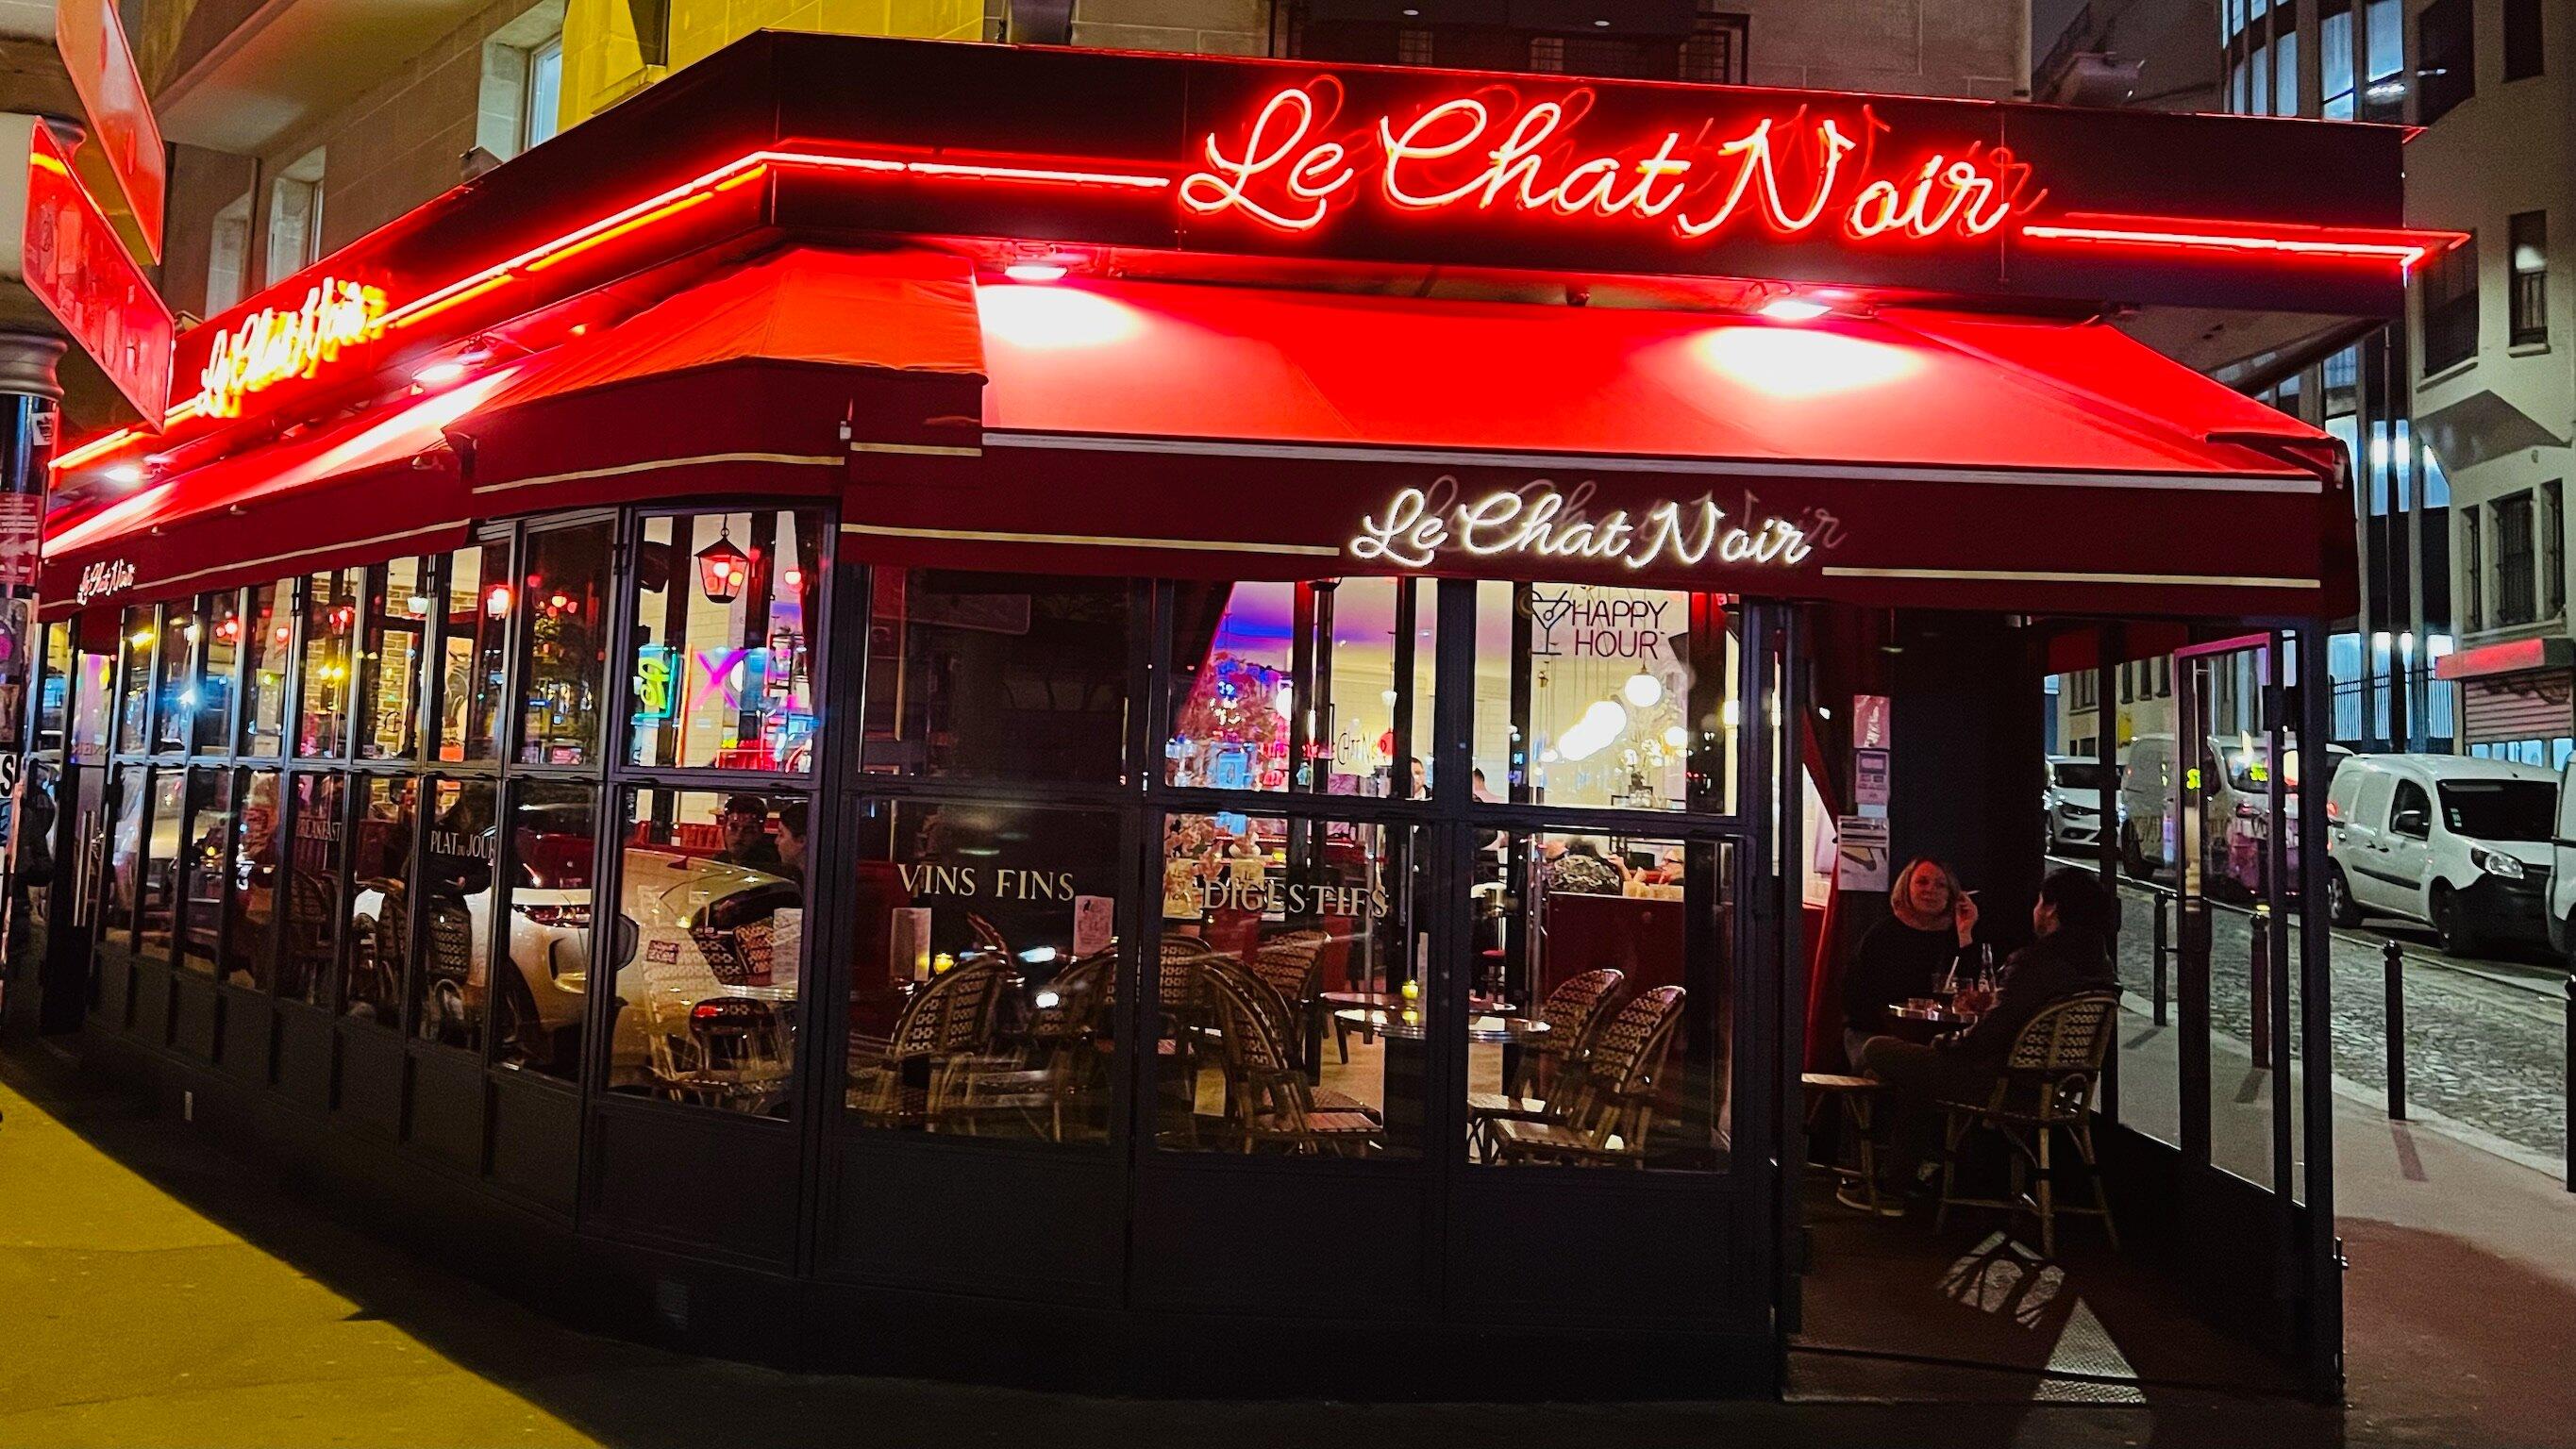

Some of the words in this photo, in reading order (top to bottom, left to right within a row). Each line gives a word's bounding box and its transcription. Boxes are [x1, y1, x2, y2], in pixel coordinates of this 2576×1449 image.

[1181, 88, 1354, 230] Le
[1380, 98, 1691, 216] Chat
[1676, 118, 2011, 238] Noir
[1349, 488, 1450, 567] Le
[1460, 491, 1634, 557] Chat
[1626, 499, 1813, 568] Noir
[1571, 599, 1668, 629] HAPPY
[1575, 628, 1659, 660] HOUR
[430, 829, 459, 854] PLAT
[466, 834, 498, 860] JOUR
[897, 863, 976, 897] VINS
[995, 869, 1076, 902] FINS
[1201, 876, 1390, 919] DIGESTIFS
